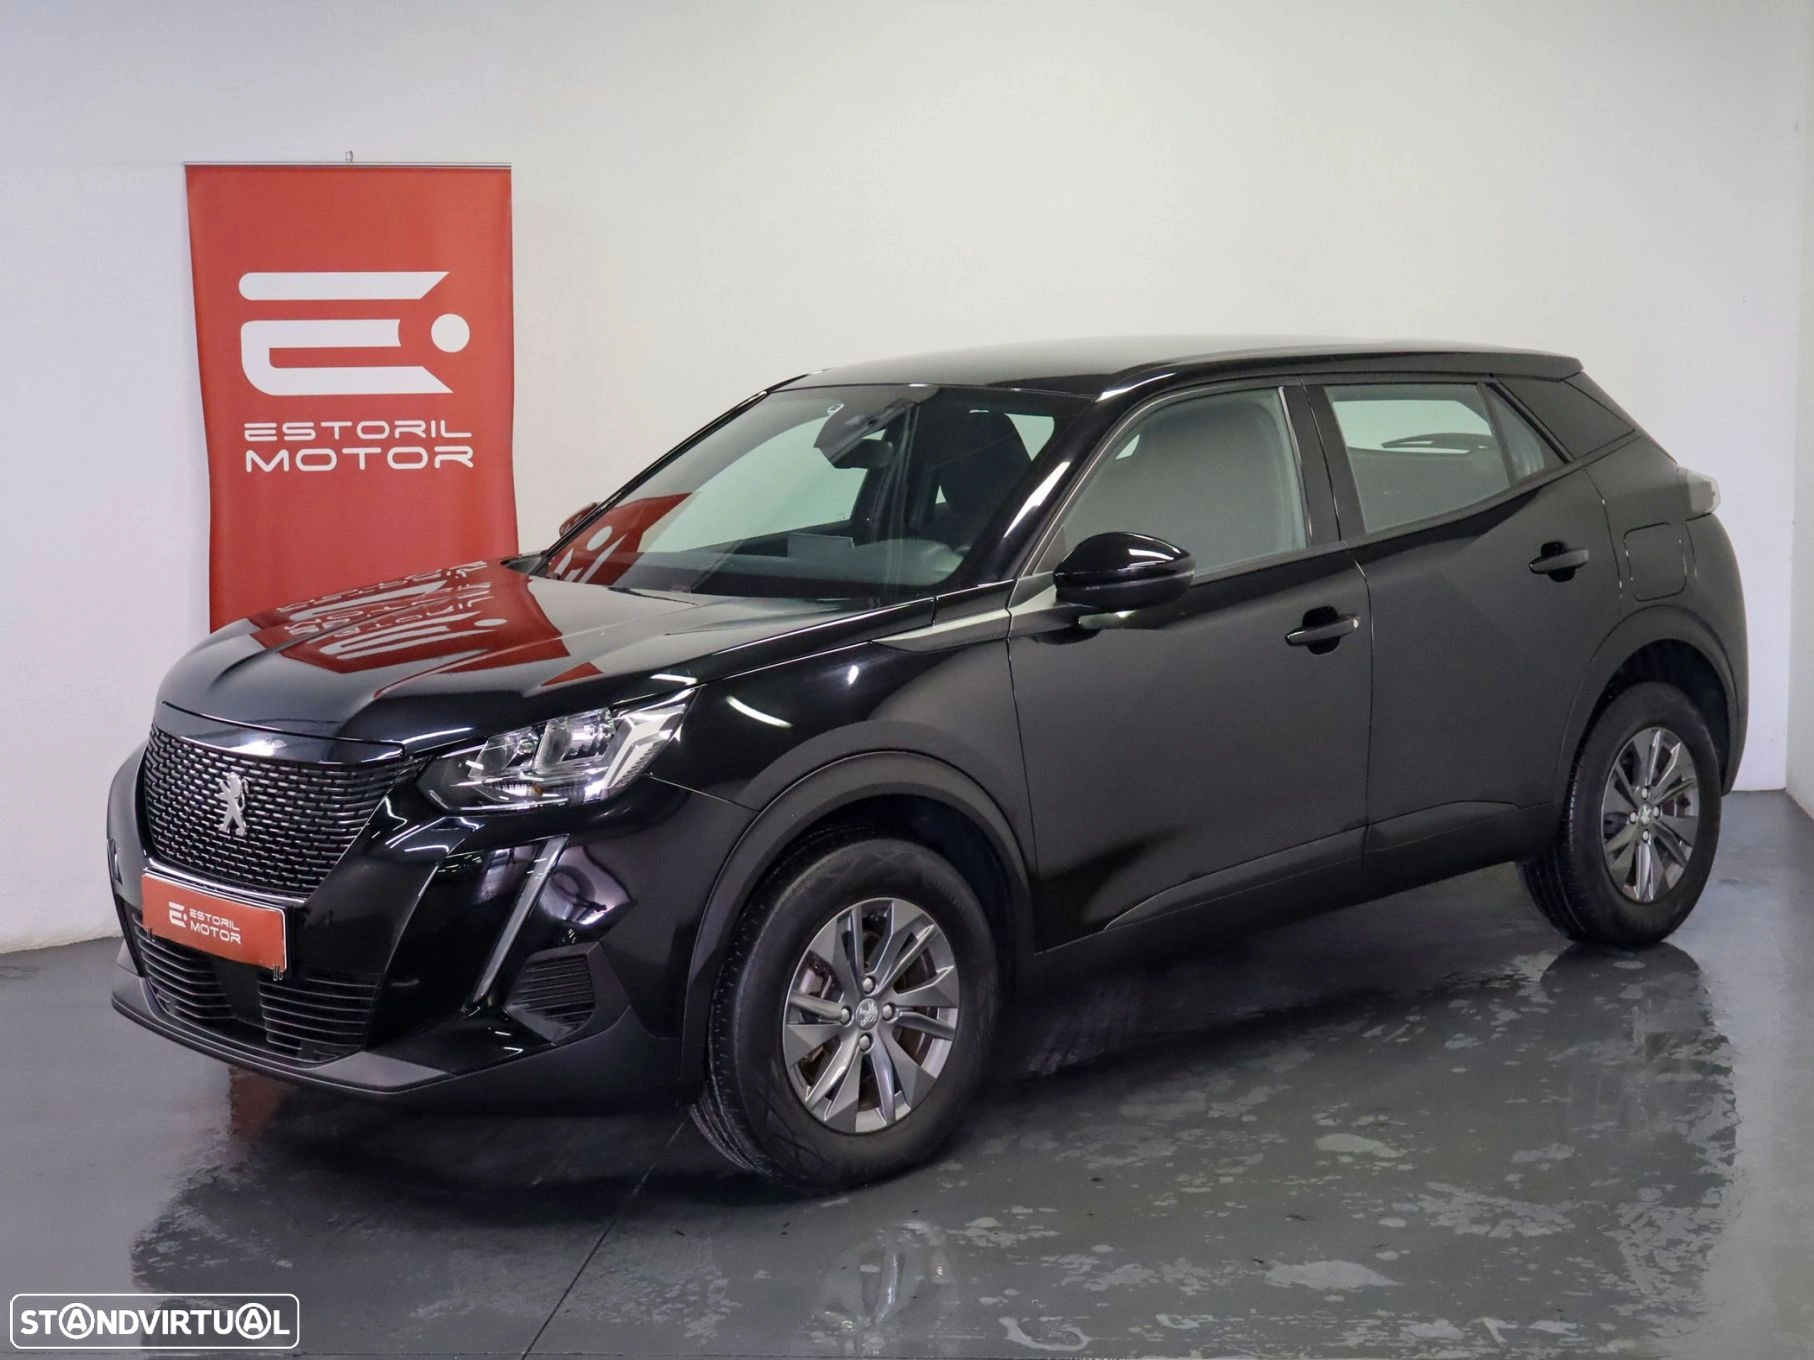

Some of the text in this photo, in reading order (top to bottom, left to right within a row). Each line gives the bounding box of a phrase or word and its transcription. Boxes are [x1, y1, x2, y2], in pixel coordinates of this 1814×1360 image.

[243, 419, 473, 442] ESTORIL
[245, 446, 475, 473] MOTOR
[189, 908, 241, 932] ESTORIL
[189, 920, 242, 944] MOTOR
